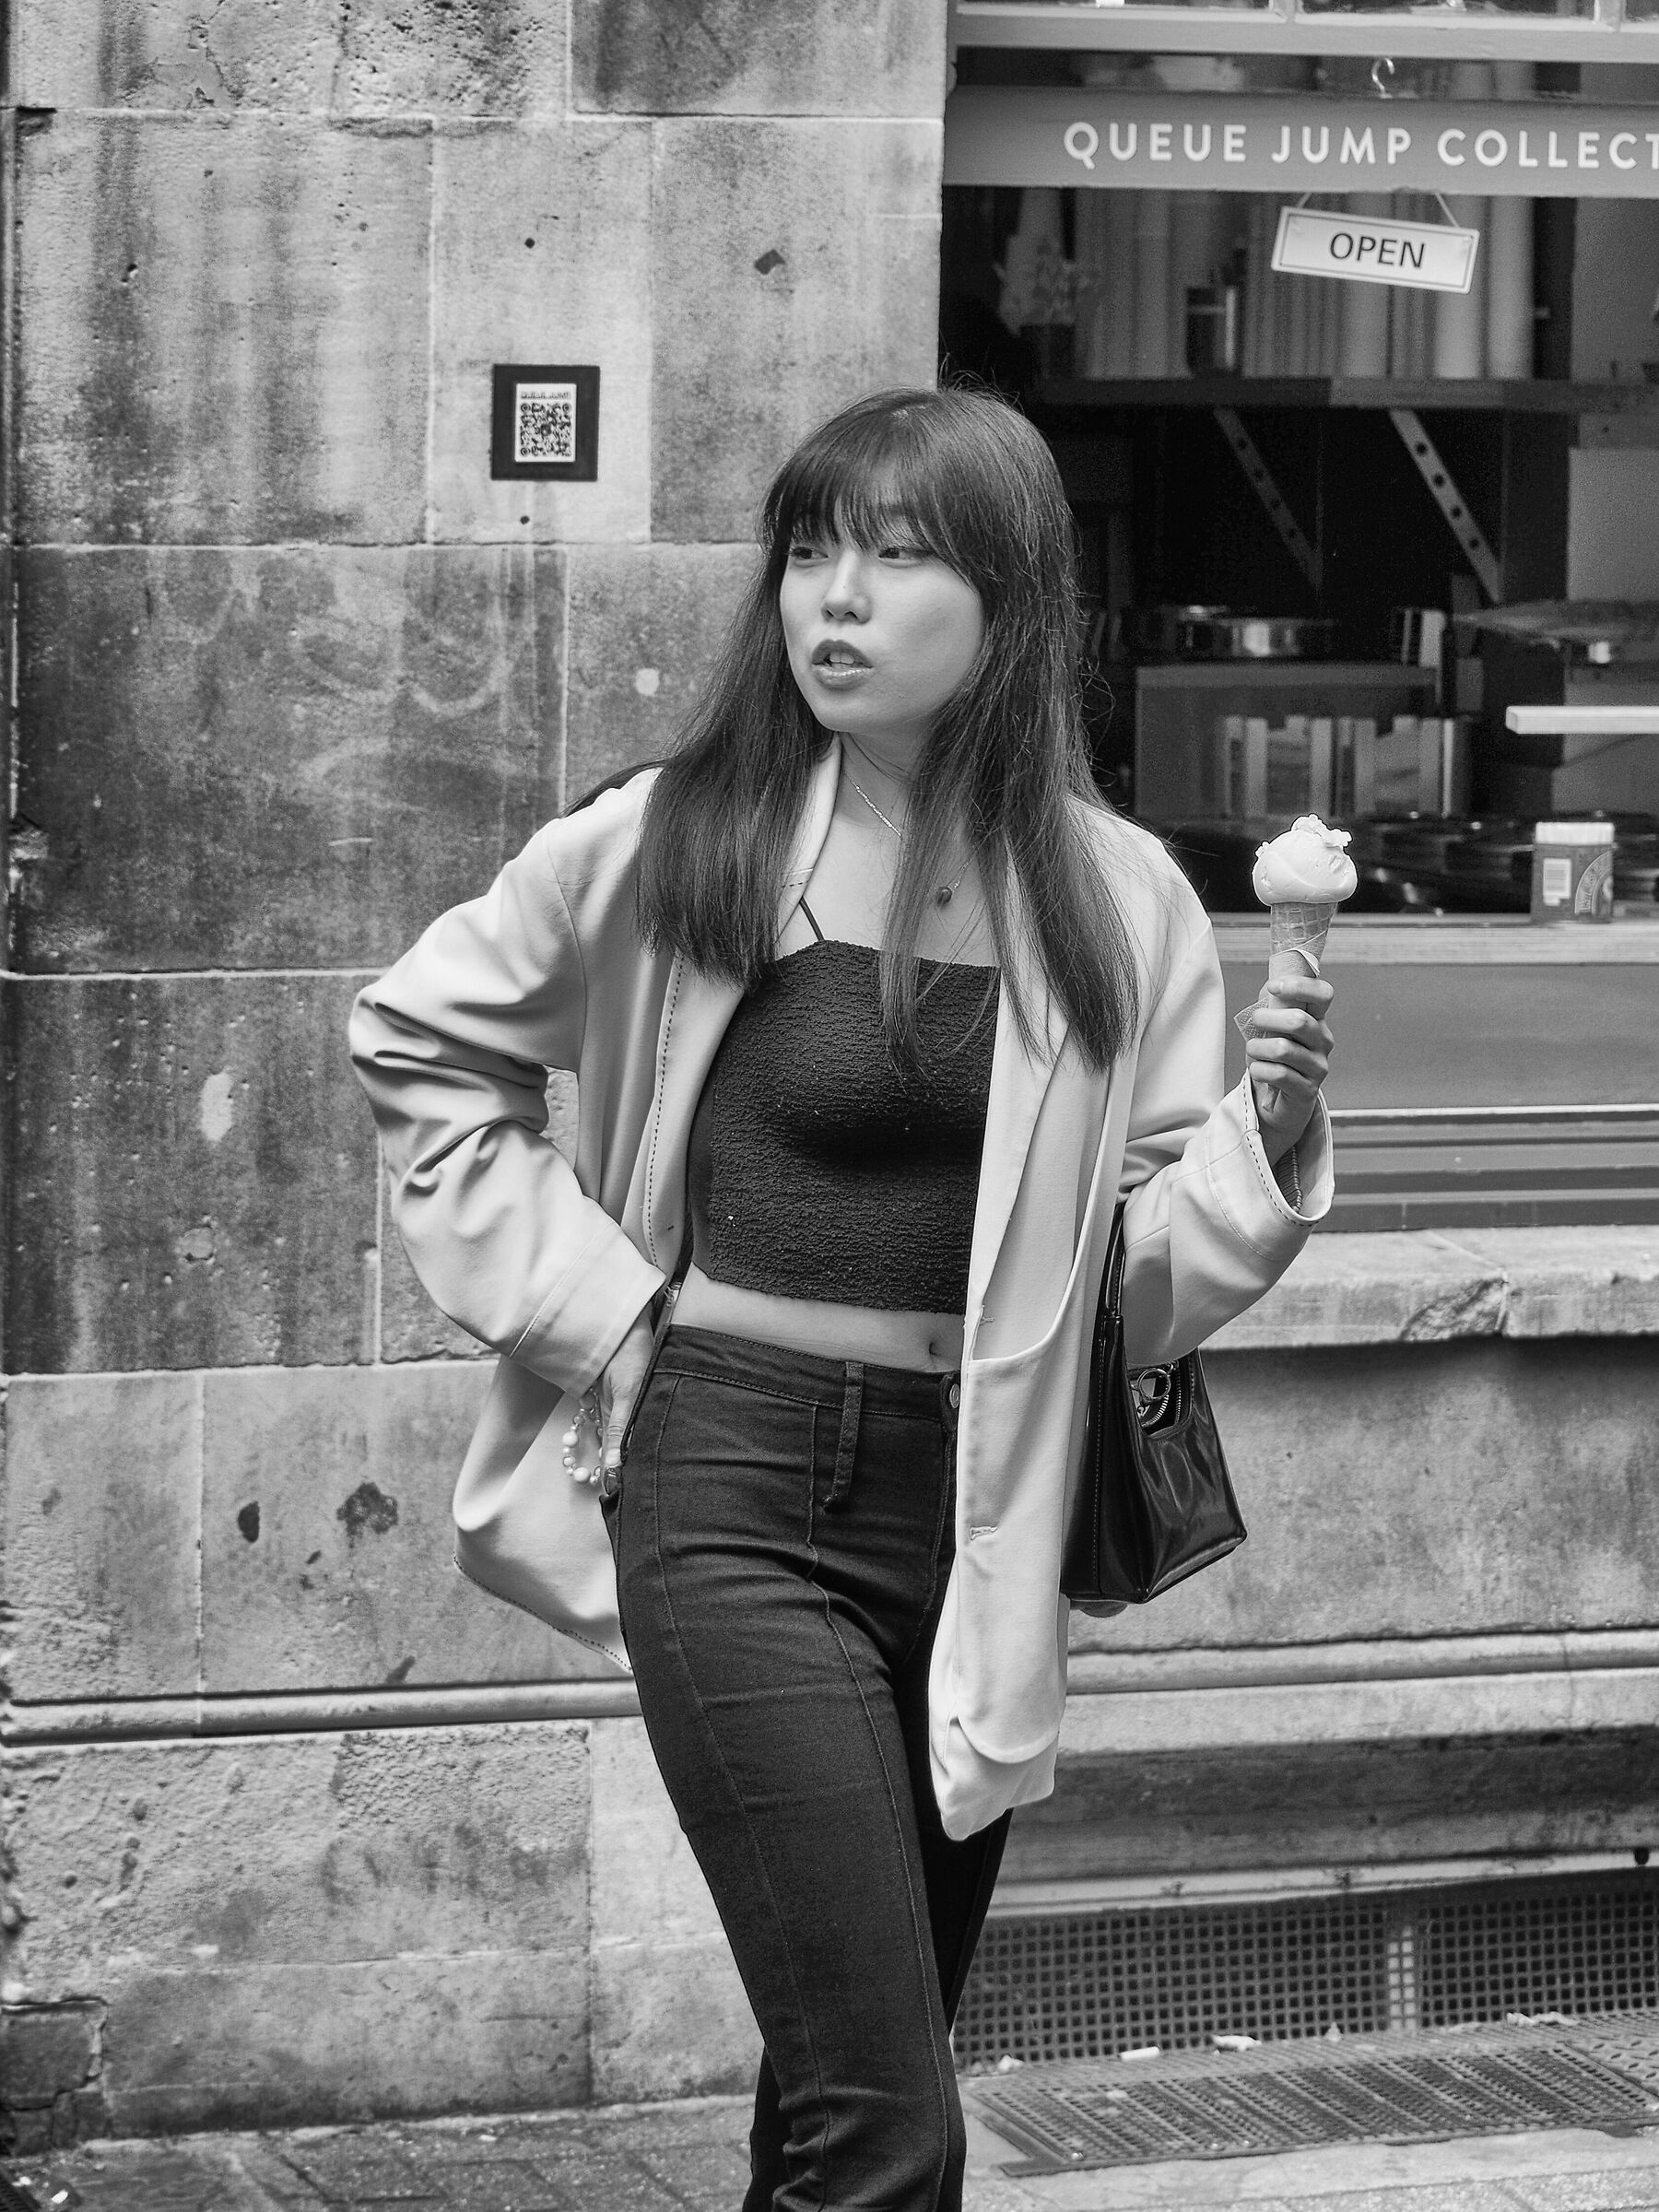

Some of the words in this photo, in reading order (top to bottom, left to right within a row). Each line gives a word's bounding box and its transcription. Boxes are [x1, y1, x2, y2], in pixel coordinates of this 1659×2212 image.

[1064, 122, 1248, 170] QUEUE
[1271, 126, 1412, 165] JUMP
[1330, 232, 1426, 268] OPEN
